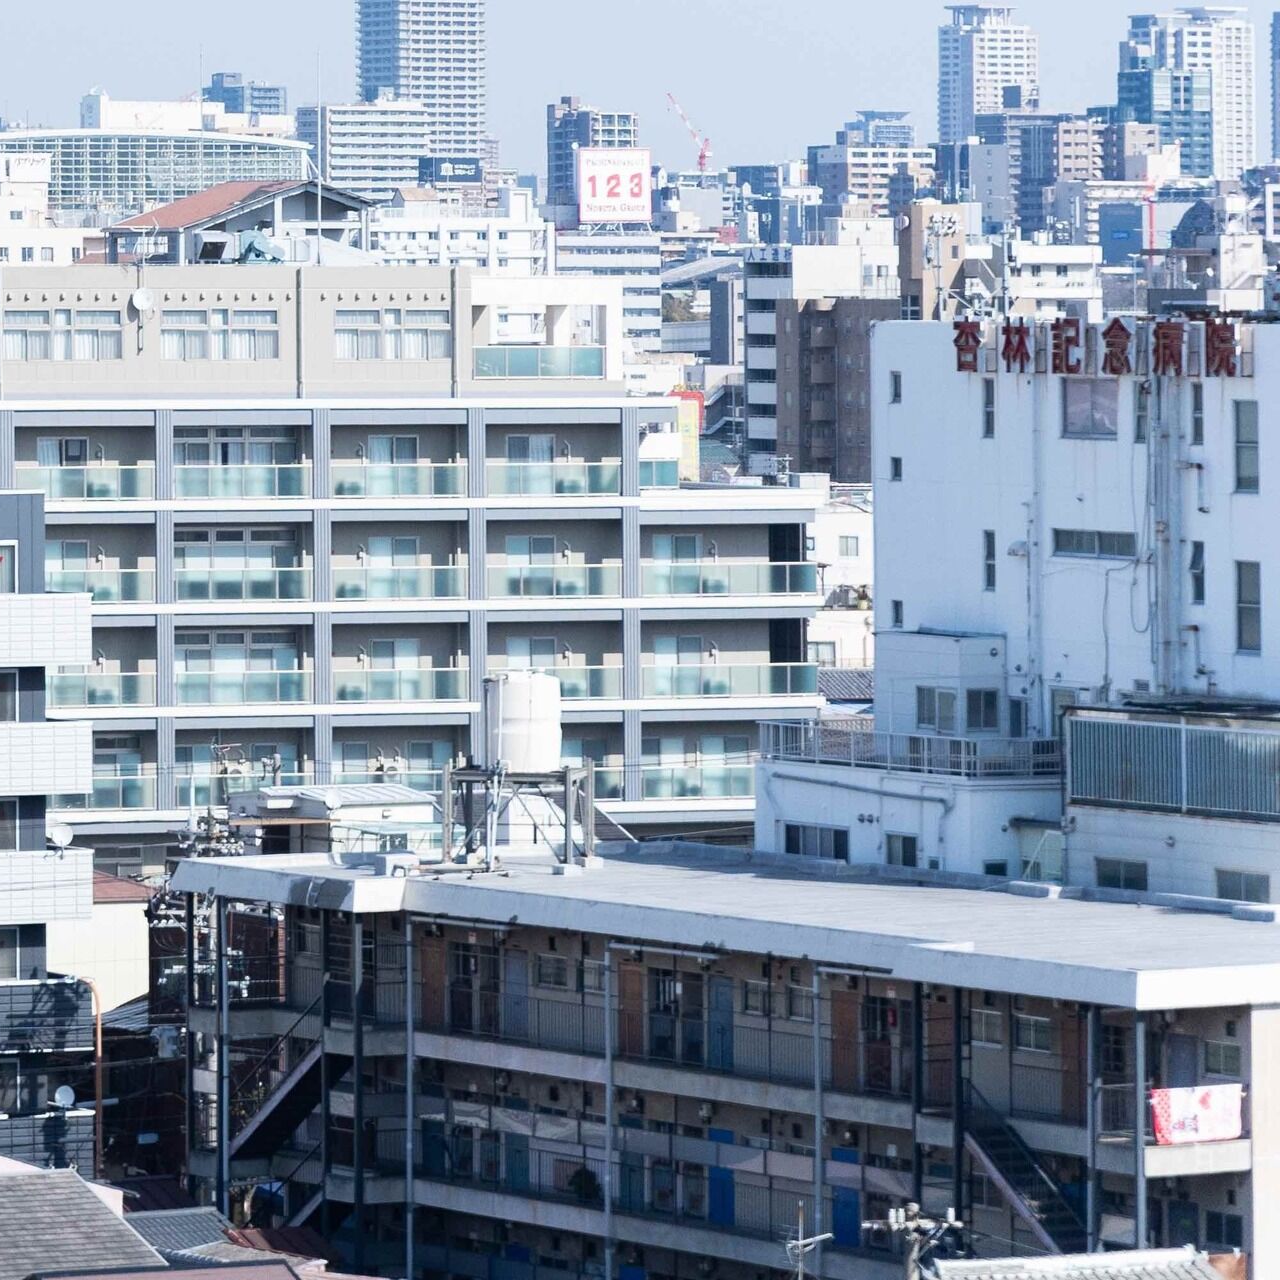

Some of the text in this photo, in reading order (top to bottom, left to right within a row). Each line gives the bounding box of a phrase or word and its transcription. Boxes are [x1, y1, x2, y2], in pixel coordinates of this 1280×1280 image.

[587, 172, 643, 198] 123
[952, 315, 1239, 378] 杏林記念病院
